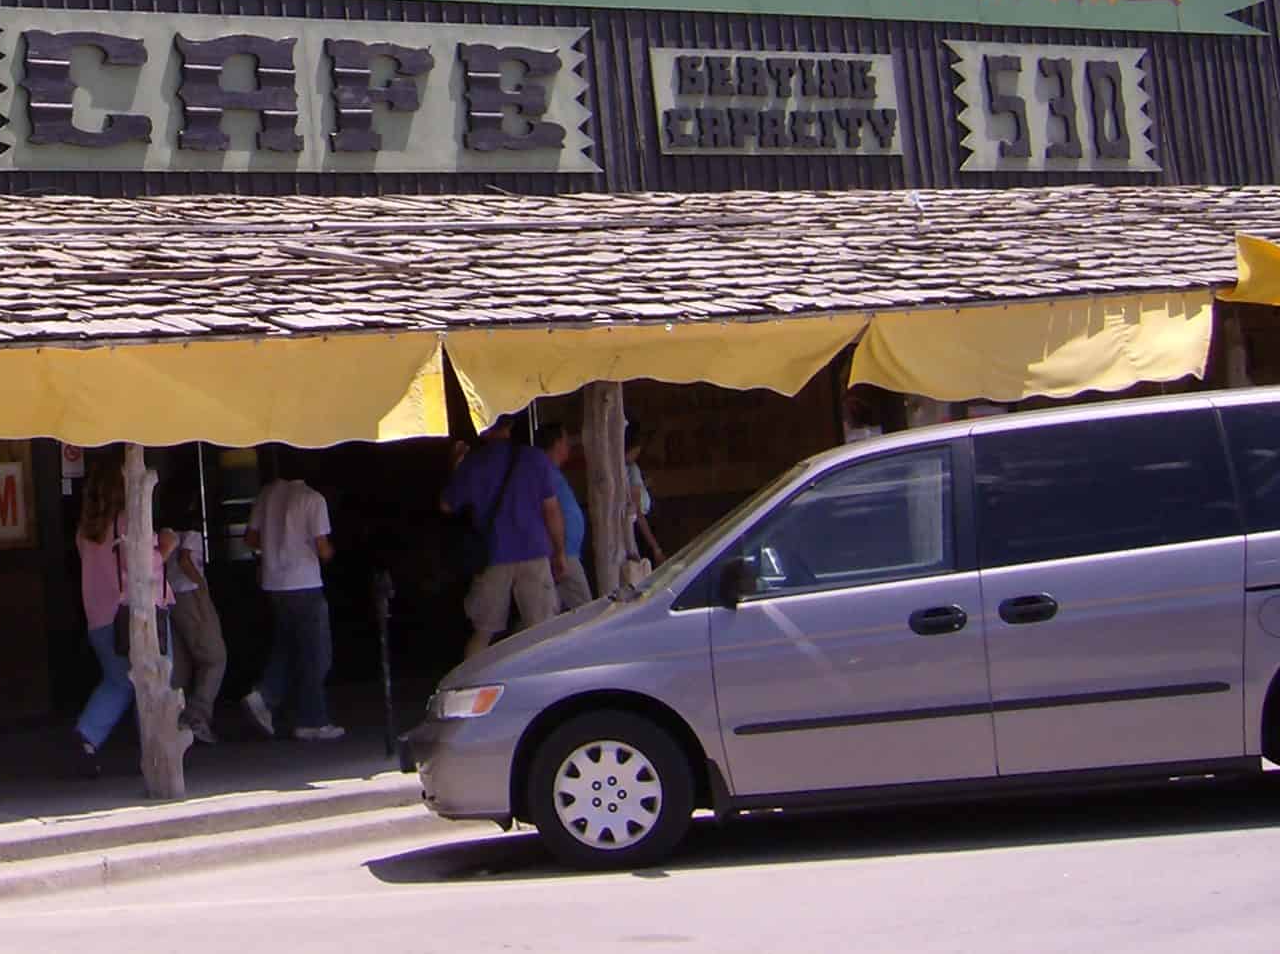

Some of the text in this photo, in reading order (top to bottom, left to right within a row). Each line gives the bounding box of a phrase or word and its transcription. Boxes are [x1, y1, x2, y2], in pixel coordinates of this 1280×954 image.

[21, 30, 567, 152] CAFE
[675, 55, 876, 99] SEATING
[663, 108, 897, 149] CAPACITY
